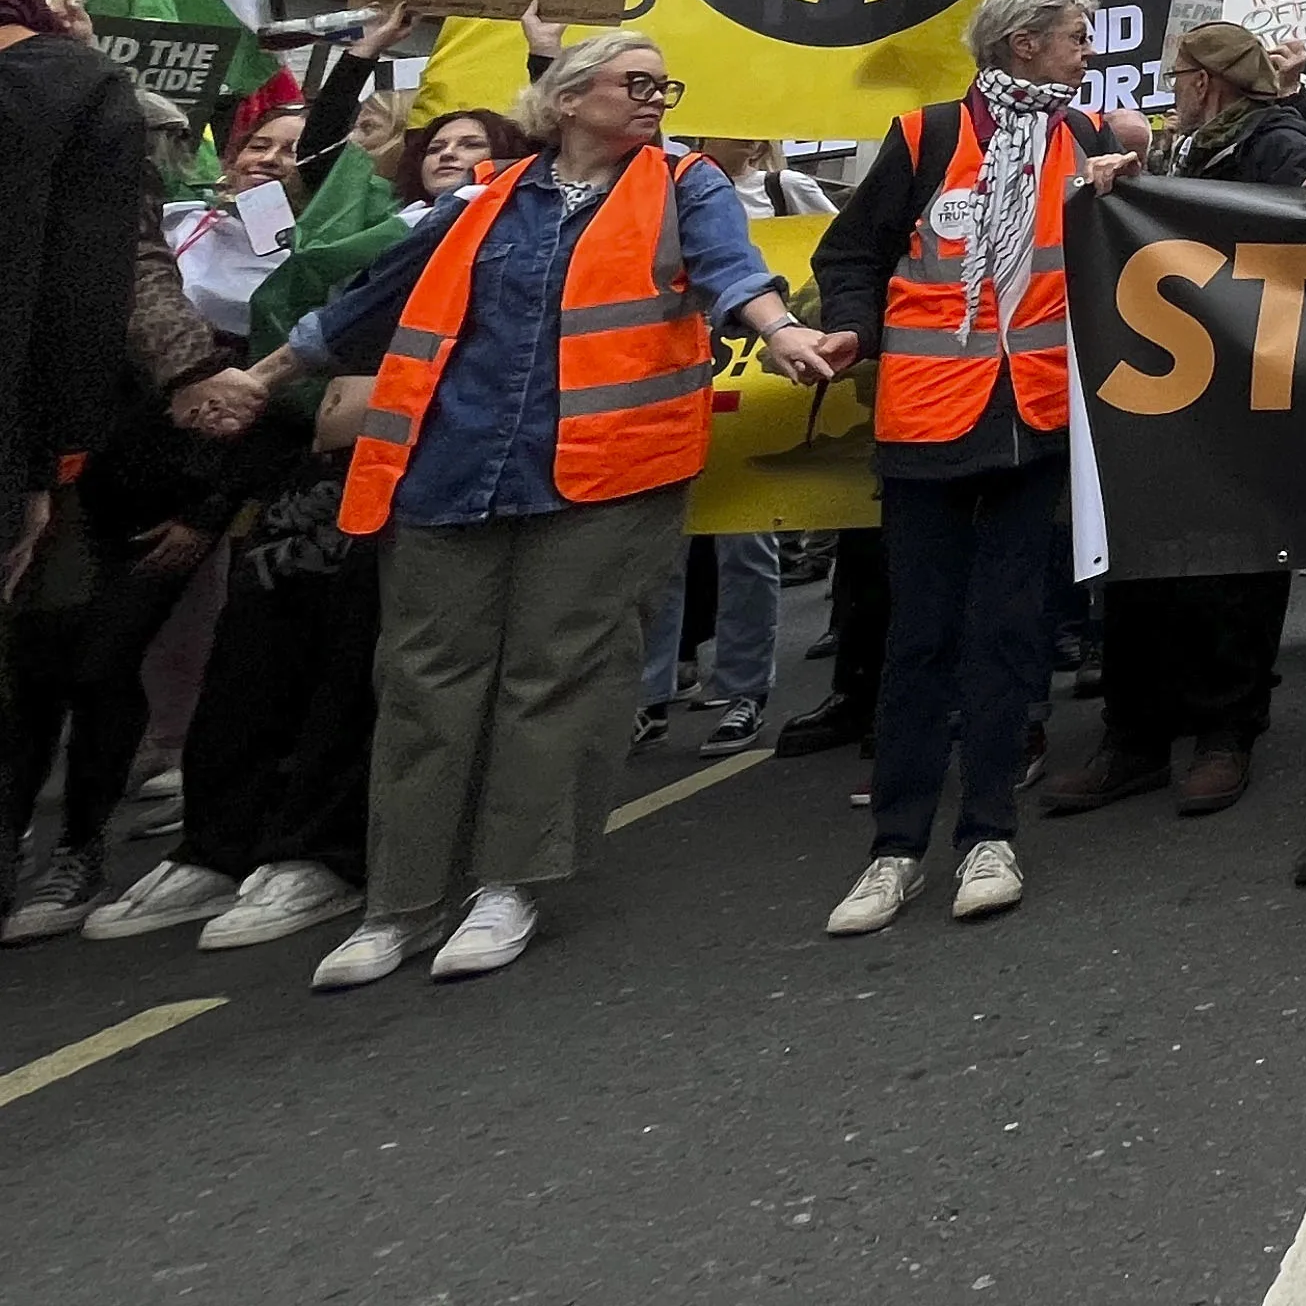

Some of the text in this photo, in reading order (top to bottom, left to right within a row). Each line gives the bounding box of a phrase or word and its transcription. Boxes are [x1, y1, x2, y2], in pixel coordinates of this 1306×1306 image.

[92, 35, 219, 69] ND THE
[125, 66, 209, 93] CIDE
[943, 200, 969, 212] STO
